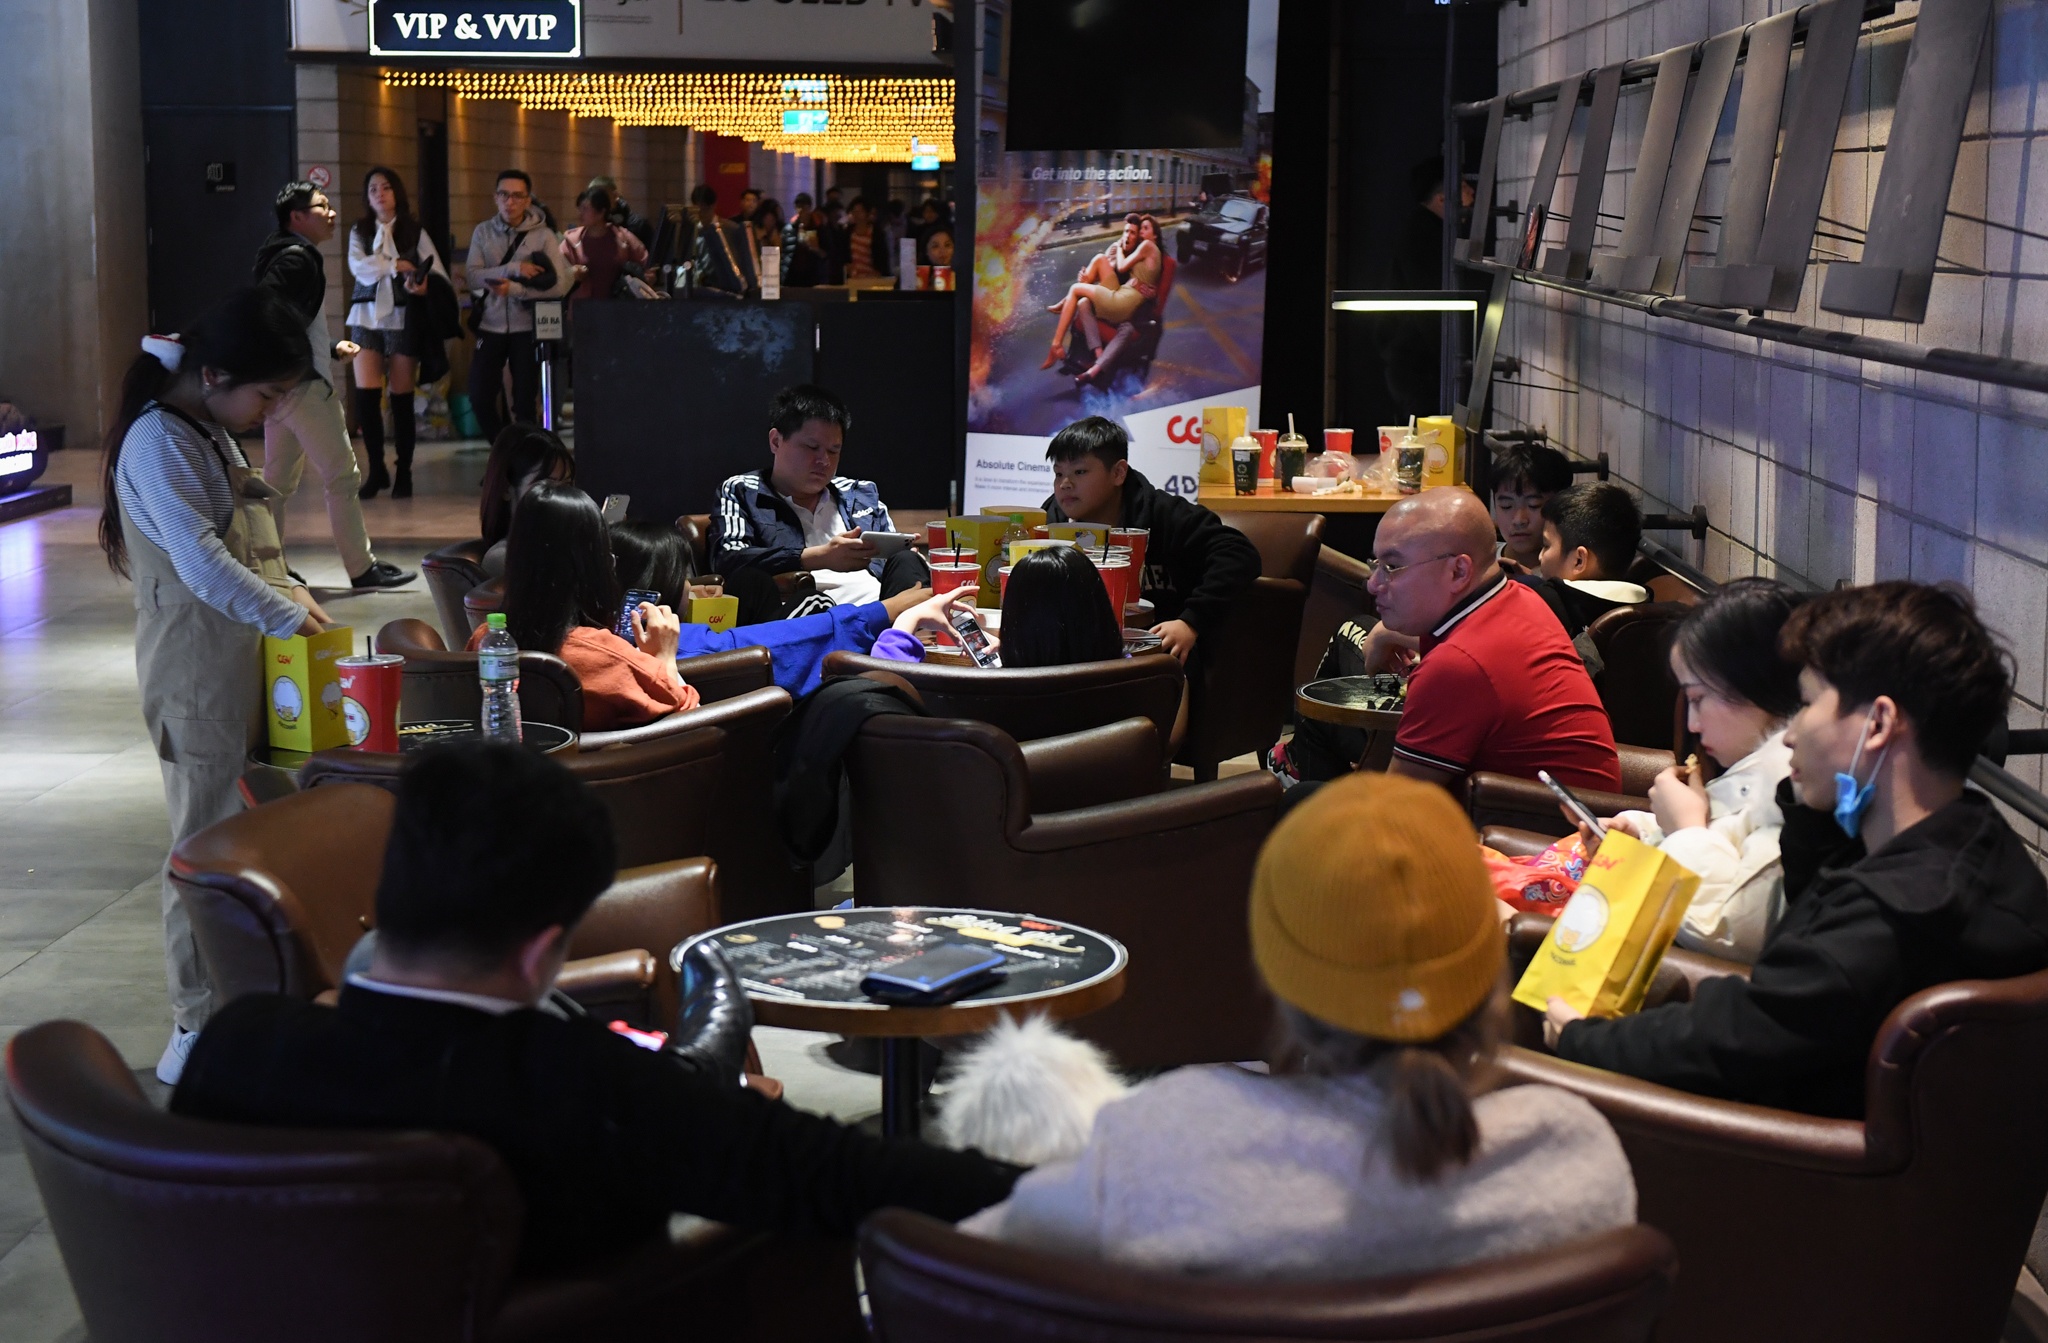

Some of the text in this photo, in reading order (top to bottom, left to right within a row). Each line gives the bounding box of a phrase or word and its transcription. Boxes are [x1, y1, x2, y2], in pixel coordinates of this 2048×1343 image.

[393, 12, 558, 40] VIP & VVIP
[1031, 165, 1153, 180] Get into the action.
[1167, 415, 1202, 444] CG
[976, 459, 1051, 472] Absolute Cinema
[708, 615, 725, 623] CGV
